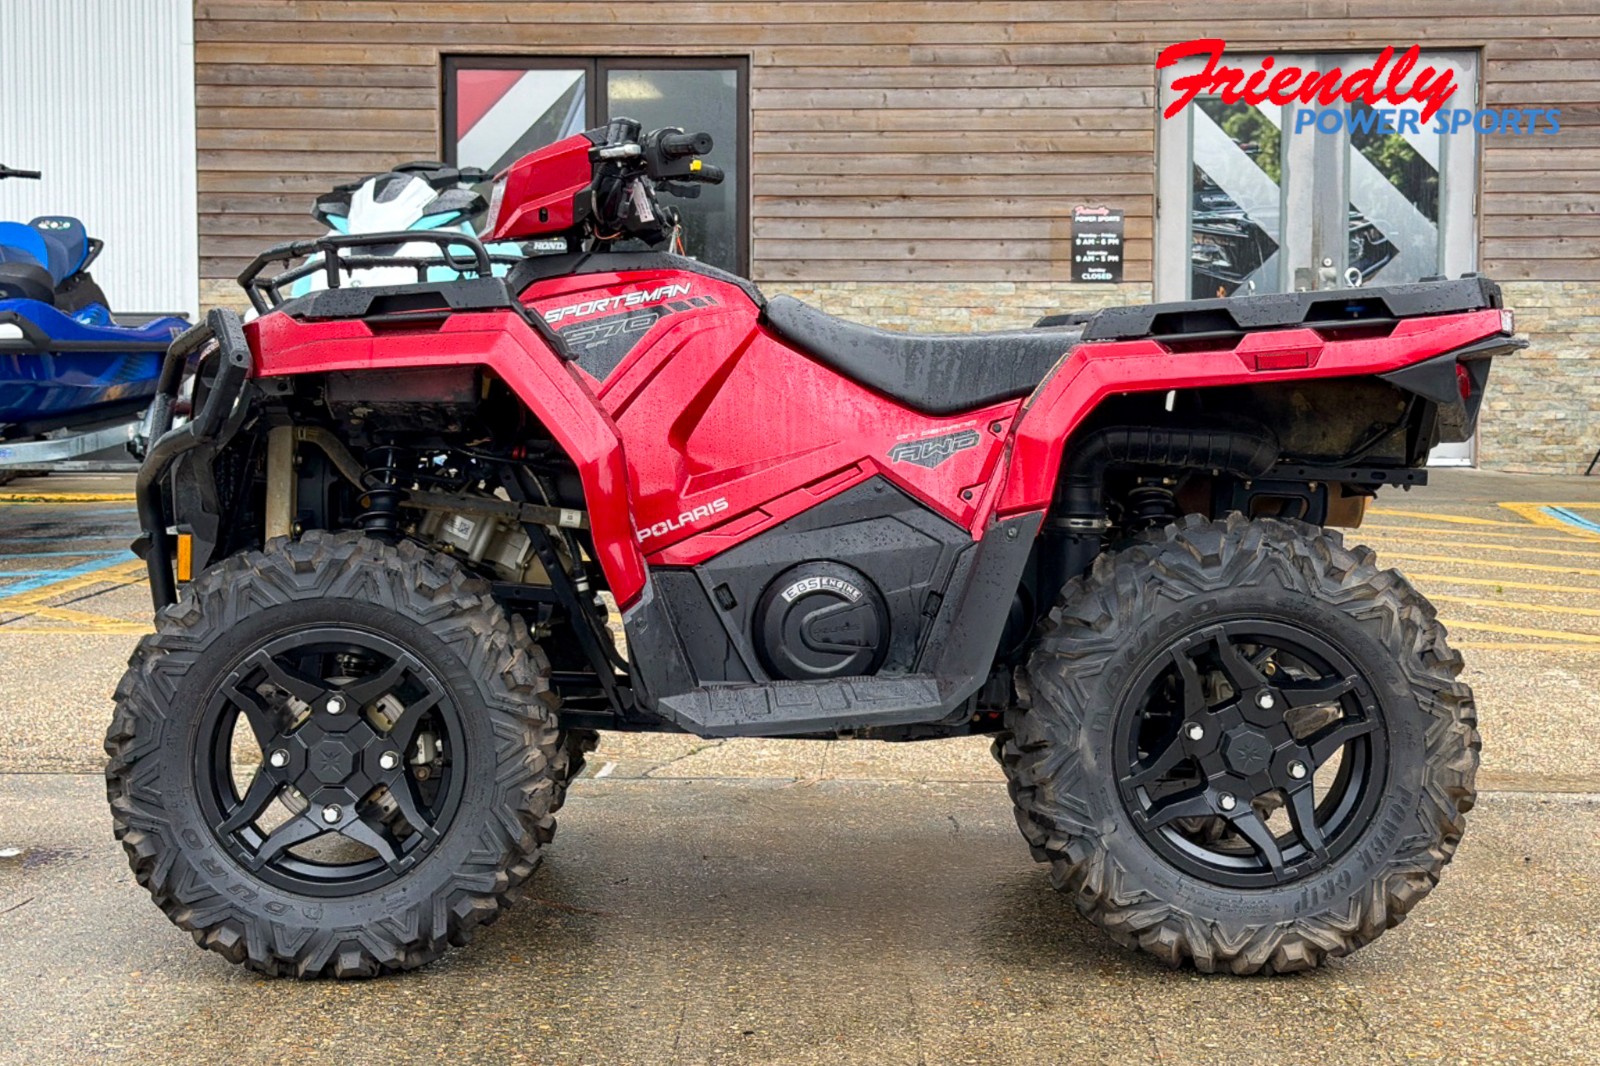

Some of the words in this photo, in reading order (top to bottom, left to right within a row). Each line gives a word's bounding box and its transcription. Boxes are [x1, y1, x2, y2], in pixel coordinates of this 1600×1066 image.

[543, 282, 692, 323] SPORTSMAN
[563, 312, 660, 346] 570
[892, 432, 980, 464] AWD
[637, 496, 729, 543] POLARIS
[785, 579, 819, 600] EBS
[821, 577, 861, 599] ENGINE
[181, 828, 295, 917] DURO
